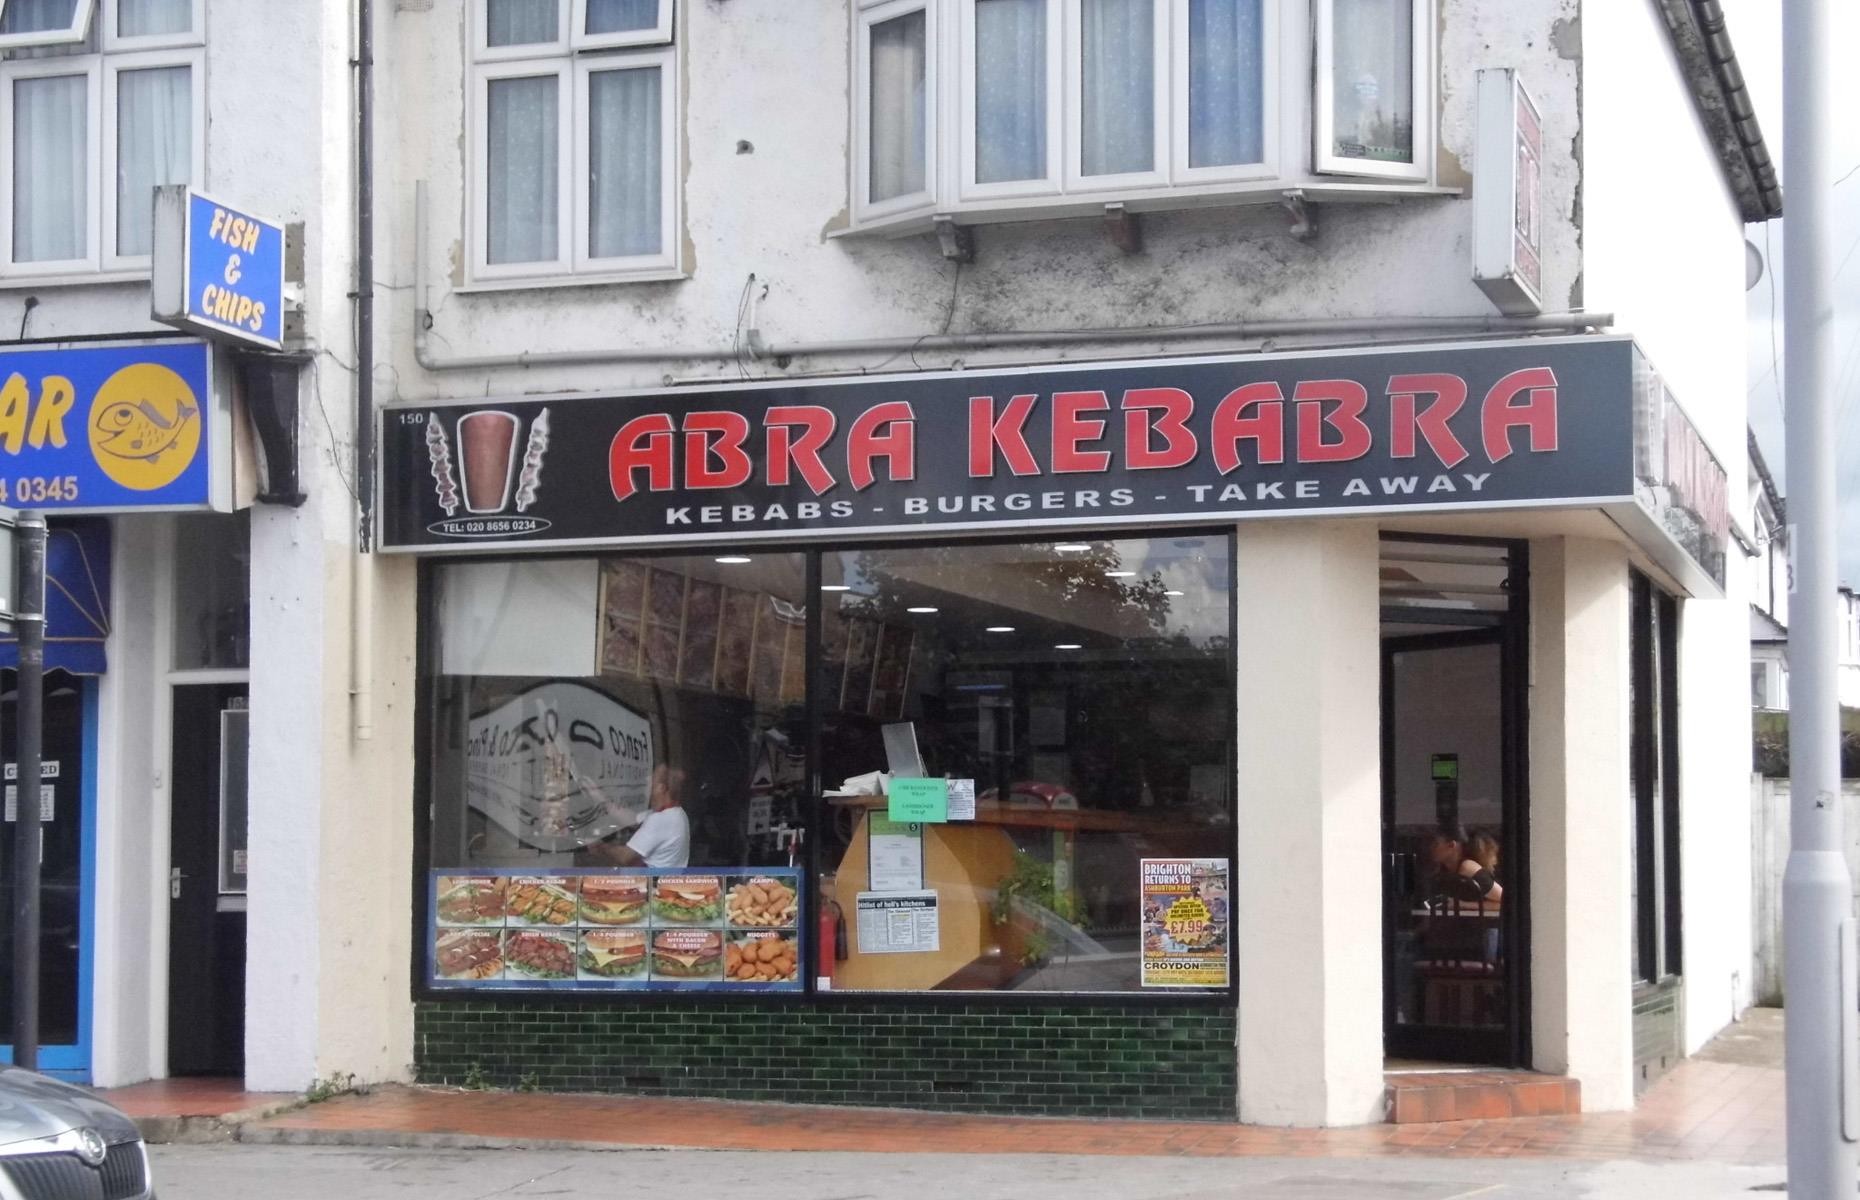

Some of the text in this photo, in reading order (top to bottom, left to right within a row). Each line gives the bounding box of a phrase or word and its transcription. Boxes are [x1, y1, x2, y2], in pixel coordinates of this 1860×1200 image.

[209, 208, 261, 254] FISH
[225, 254, 242, 285] &
[201, 284, 266, 332] CHIPS
[399, 412, 424, 425] 150
[608, 366, 1559, 503] ABRA KEBABRA
[16, 476, 79, 502] 0345
[666, 499, 854, 525] KEBABS
[904, 489, 1135, 516] BURGERS
[1186, 480, 1320, 503] TAKE
[1342, 472, 1493, 497] AWAY
[443, 520, 536, 533] TEL: 020 8656 0234
[6, 765, 57, 777] CED
[1144, 863, 1192, 875] BRIGHTON
[1144, 875, 1192, 885] RETURNS TO
[1171, 920, 1203, 934] £7.99
[1144, 962, 1200, 970] CROYDON
